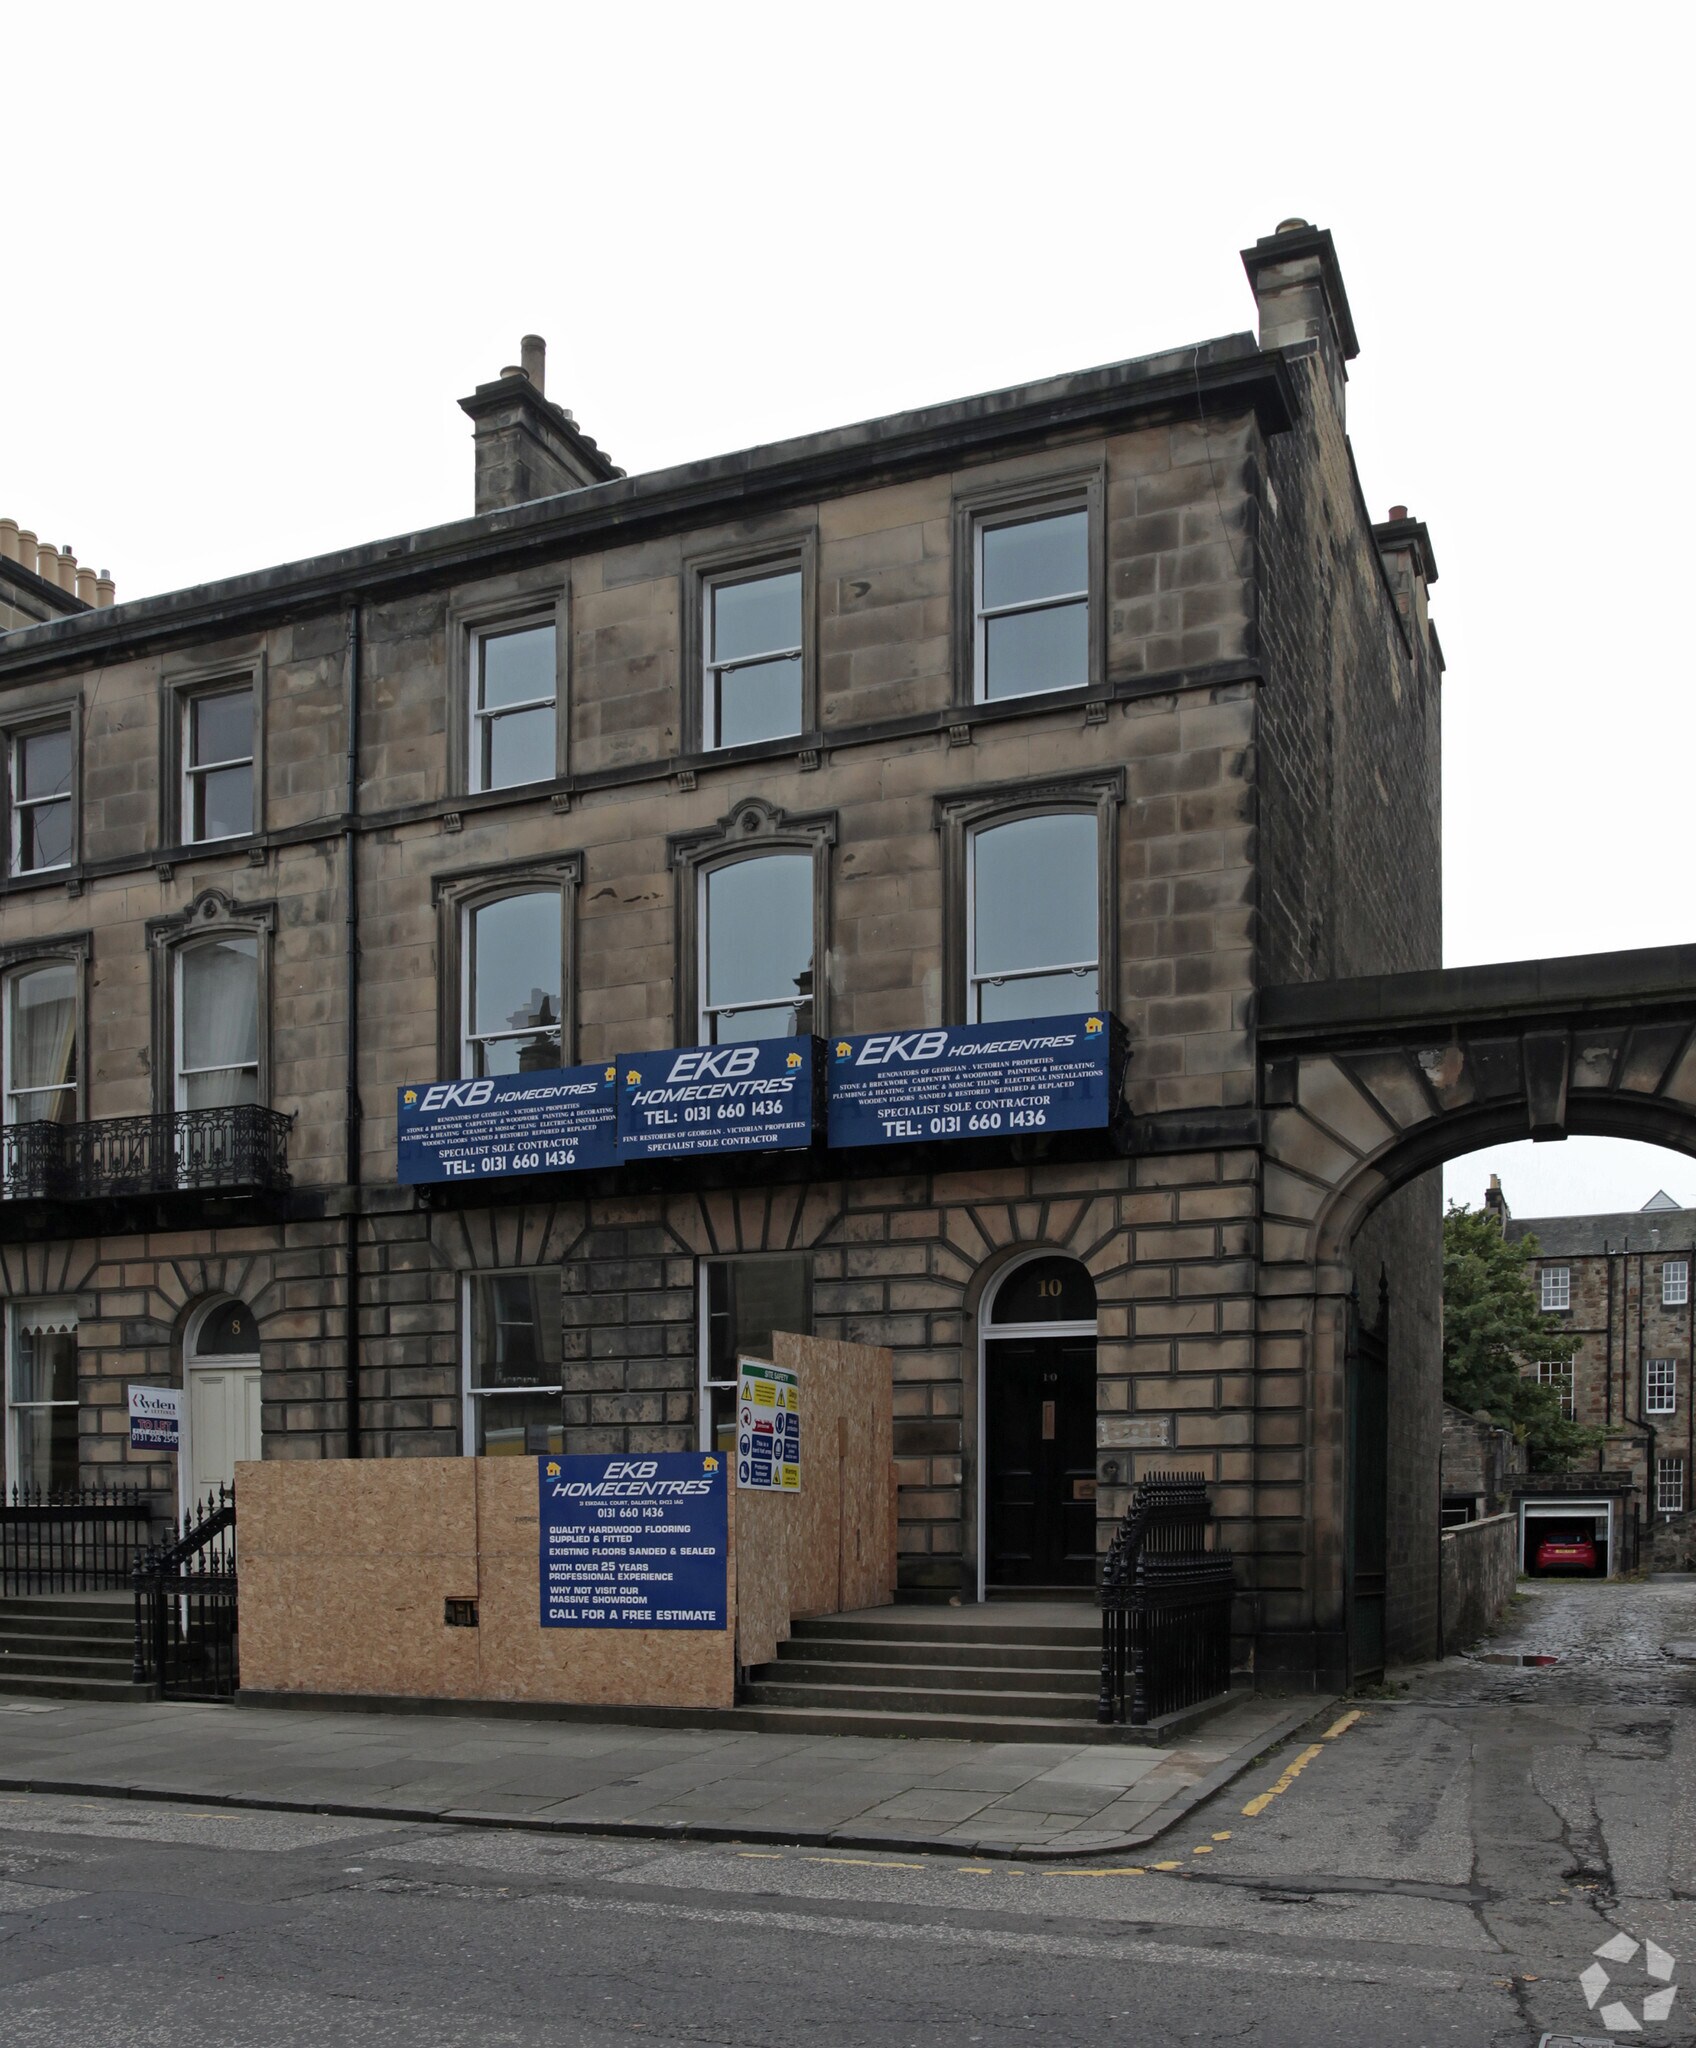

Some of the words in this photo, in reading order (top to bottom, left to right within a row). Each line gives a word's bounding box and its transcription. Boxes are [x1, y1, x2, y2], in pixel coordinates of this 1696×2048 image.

[855, 1031, 948, 1066] EKB
[948, 1035, 1076, 1057] HOMECENTRES
[666, 1048, 759, 1083] EKB
[870, 1079, 908, 1088] BRICKWORK
[912, 1075, 951, 1084] CARPENTRY
[963, 1070, 1002, 1080] WOODWORK
[1007, 1067, 1040, 1076] PAINTING
[1050, 1062, 1095, 1072] DECORATING
[878, 1069, 919, 1079] RENOVATORS
[932, 1065, 966, 1074] GEORGIAN
[973, 1061, 1009, 1070] VICTORIAN
[1012, 1057, 1054, 1066] PROPERTIES
[632, 1077, 796, 1106] HOMECENTRES
[833, 1091, 866, 1099] PLUMBING
[875, 1087, 904, 1096] HEATING
[908, 1084, 939, 1093] CERAMIC
[949, 1081, 974, 1089] MOSIAC
[977, 1079, 1000, 1087] TILING
[1005, 1075, 1046, 1084] ELECTRICAL
[1049, 1070, 1103, 1080] INSTALLATIONS
[858, 1097, 887, 1105] WOODEN
[919, 1092, 946, 1100] SANDED
[955, 1088, 990, 1097] RESTORED
[995, 1085, 1028, 1094] REPAIRED
[1038, 1081, 1074, 1090] REPLACED
[419, 1081, 494, 1111] EKB
[494, 1083, 598, 1103] HOMECENTRES
[438, 1114, 471, 1122] RENOVATORS
[481, 1110, 509, 1118] GEORGIAN
[546, 1103, 580, 1111] PROPERTIES
[644, 1110, 678, 1125] TEL:
[685, 1106, 710, 1121] 0131
[717, 1103, 745, 1118] 660
[752, 1100, 783, 1116] 1436
[878, 1105, 940, 1118] SPECIALIST
[944, 1102, 971, 1113] SOLE
[975, 1096, 1050, 1111] CONTRACTOR
[431, 1123, 462, 1131] BRICKWORK
[465, 1119, 496, 1127] CARPENTRY
[506, 1115, 539, 1123] WOODWORK
[577, 1108, 613, 1116] DECORATING
[540, 1119, 574, 1127] ELECTRICAL
[882, 1120, 921, 1137] TEL:
[930, 1116, 960, 1133] 0131
[969, 1113, 1000, 1130] 660
[1010, 1110, 1046, 1127] 1436
[471, 1134, 493, 1142] SANDED
[500, 1131, 528, 1139] RESTORED
[532, 1128, 559, 1136] REPAIRED
[567, 1125, 597, 1133] REPLACED
[640, 1132, 676, 1141] RESTORERS
[687, 1128, 721, 1137] GEORGIAN
[727, 1125, 762, 1133] VICTORIAN
[765, 1121, 805, 1130] PROPERTIES
[439, 1146, 489, 1158] SPECIALIST
[492, 1143, 514, 1153] SOLE
[518, 1137, 578, 1151] CONTRACTOR
[648, 1141, 695, 1152] SPECIALIST
[697, 1139, 718, 1147] SOLE
[721, 1134, 778, 1146] CONTRACTOR
[443, 1160, 475, 1175] TEL:
[482, 1156, 506, 1172] 0131
[513, 1153, 539, 1169] 660
[546, 1150, 575, 1166] 1436
[1037, 1279, 1062, 1296] 10
[232, 1320, 240, 1334] 8
[765, 1370, 773, 1379] SITE
[1043, 1373, 1057, 1381] 10
[133, 1394, 175, 1413] Ryden
[138, 1419, 152, 1430] TO
[154, 1421, 172, 1431] LET
[603, 1461, 658, 1479] EKB
[552, 1480, 713, 1497] HOMECENTRES
[598, 1508, 615, 1517] 0131
[620, 1508, 638, 1517] 660
[643, 1508, 664, 1517] 1436
[601, 1562, 615, 1571] 25
[550, 1609, 578, 1618] CALL
[582, 1610, 605, 1619] FOR
[610, 1610, 618, 1619] A
[622, 1610, 651, 1620] FREE
[657, 1611, 716, 1620] ESTIMATE
